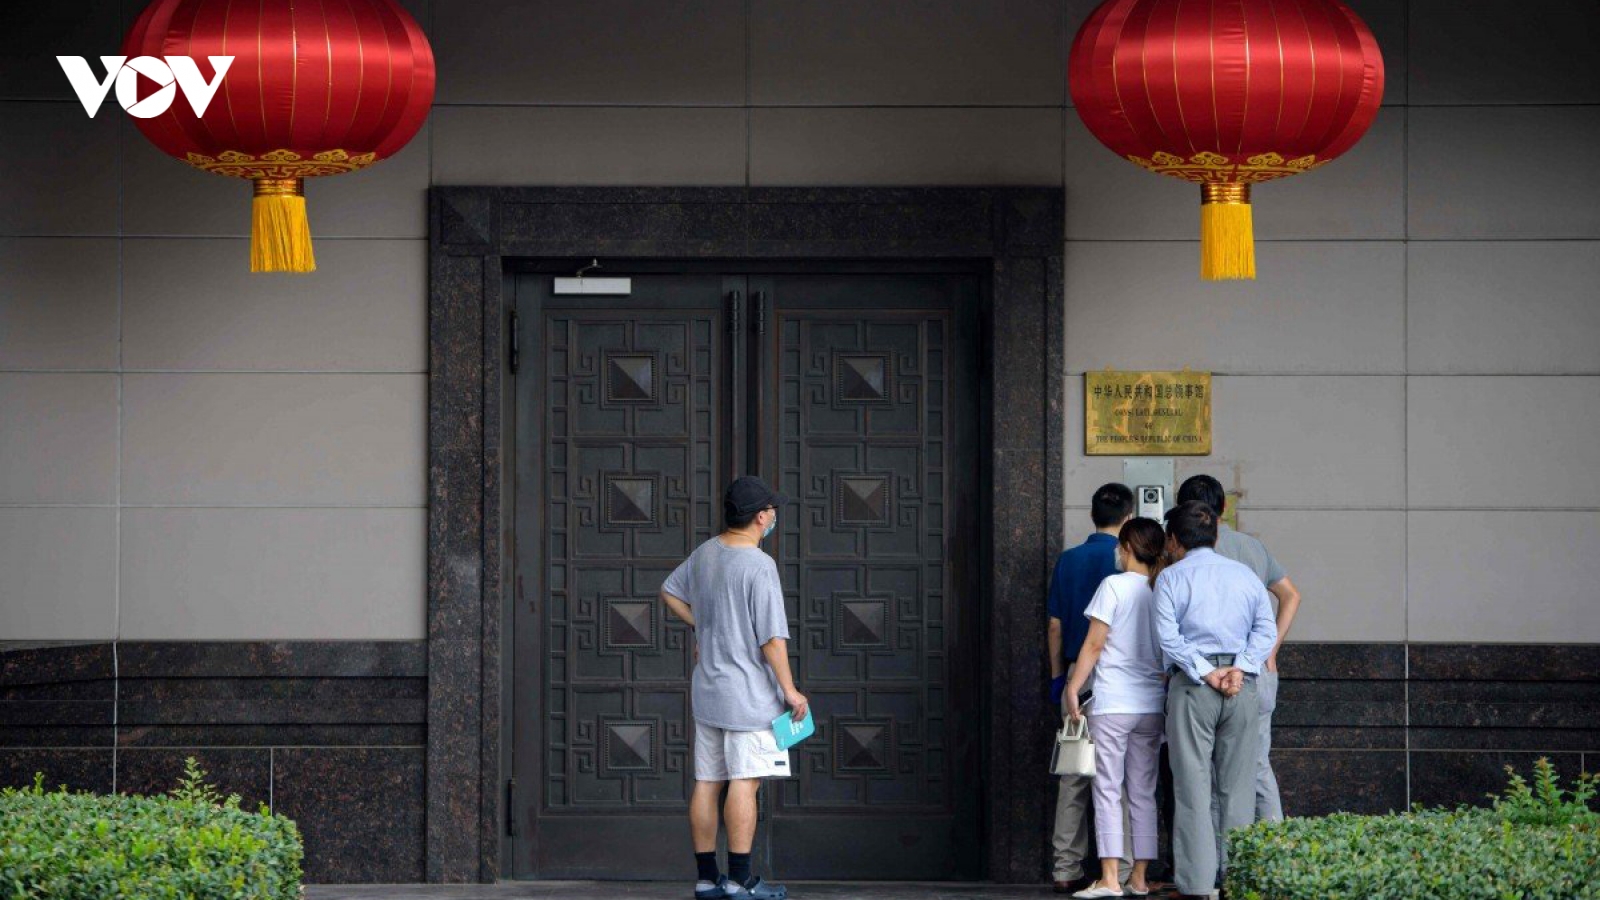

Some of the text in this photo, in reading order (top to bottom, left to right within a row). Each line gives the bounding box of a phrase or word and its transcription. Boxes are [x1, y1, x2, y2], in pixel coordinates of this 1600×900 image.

[1094, 383, 1204, 399] 中华人民共和国总领事馆
